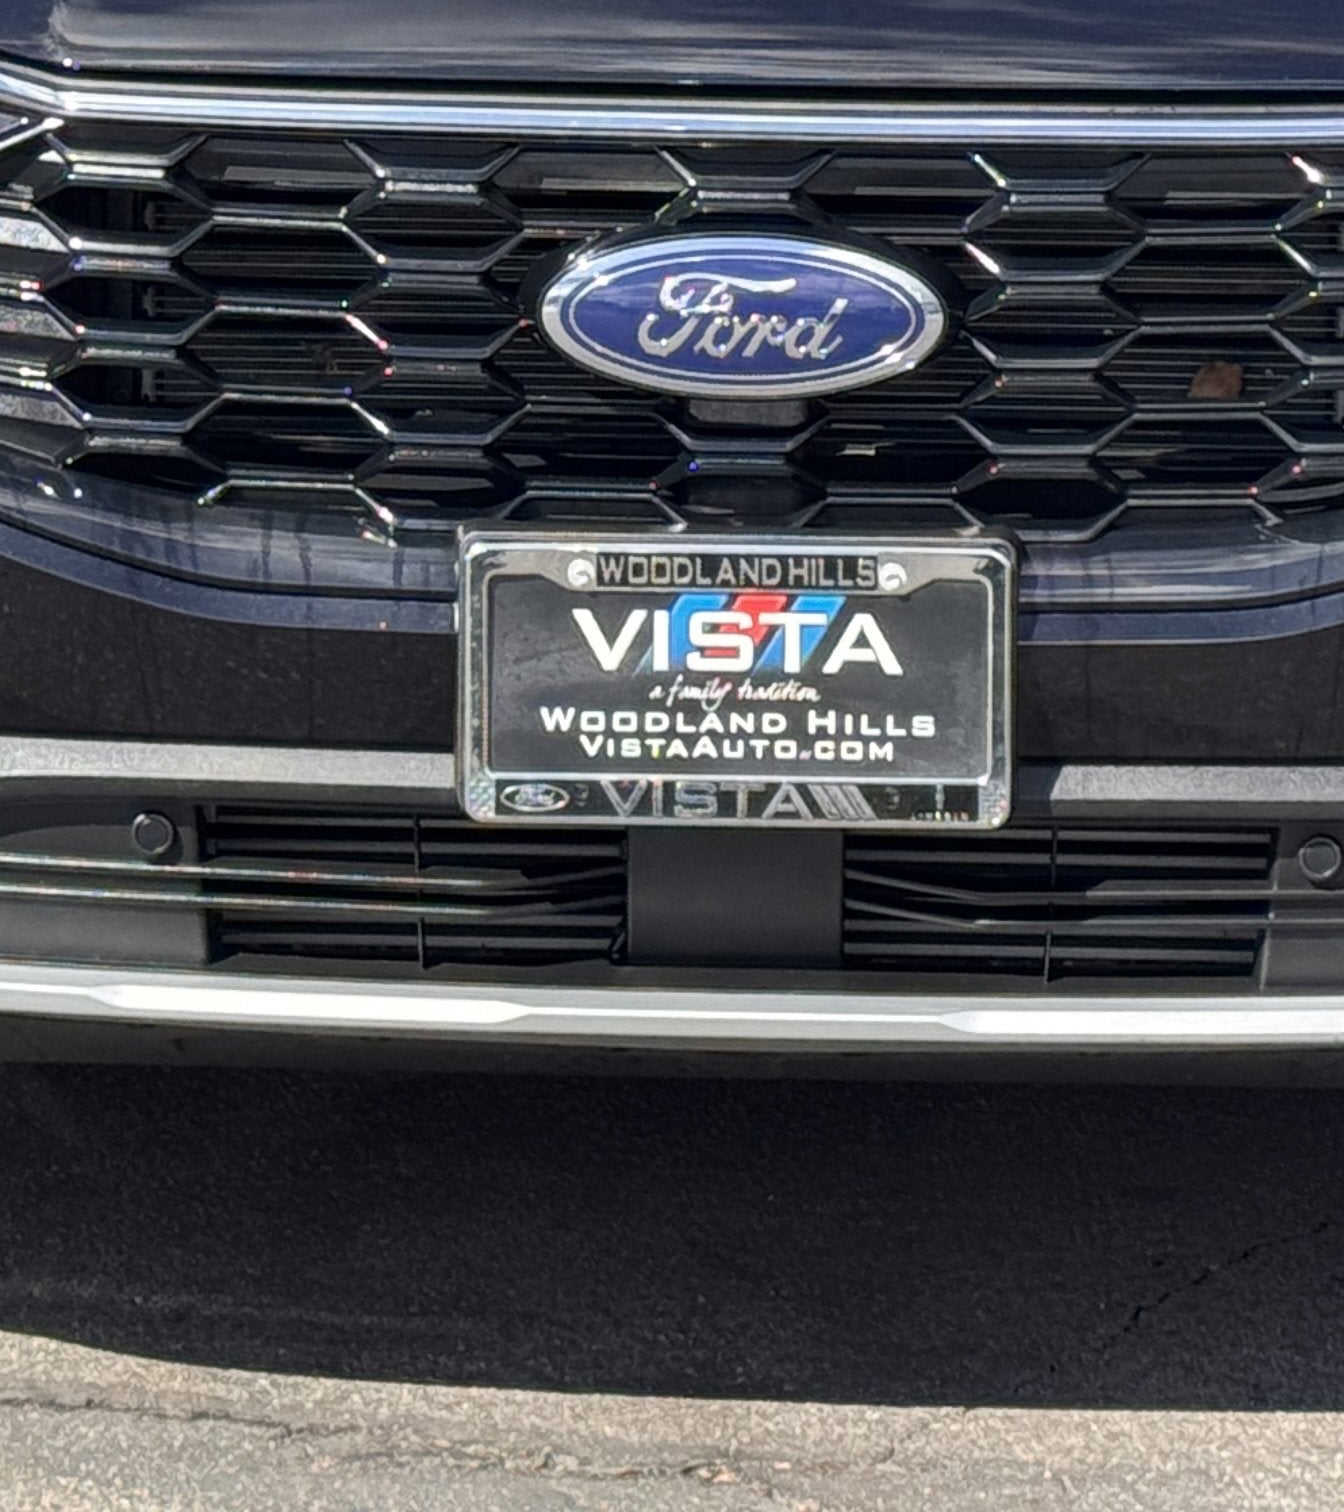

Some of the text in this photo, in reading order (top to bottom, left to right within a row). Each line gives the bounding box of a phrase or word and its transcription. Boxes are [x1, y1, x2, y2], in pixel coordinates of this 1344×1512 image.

[637, 272, 849, 361] Ford
[599, 554, 878, 589] WOODLAND HILLS
[572, 608, 904, 676] VISTA
[665, 674, 733, 712] family
[736, 677, 822, 702] tradition
[540, 706, 937, 738] WOODLAND HILLS
[601, 780, 813, 819] VISTA
